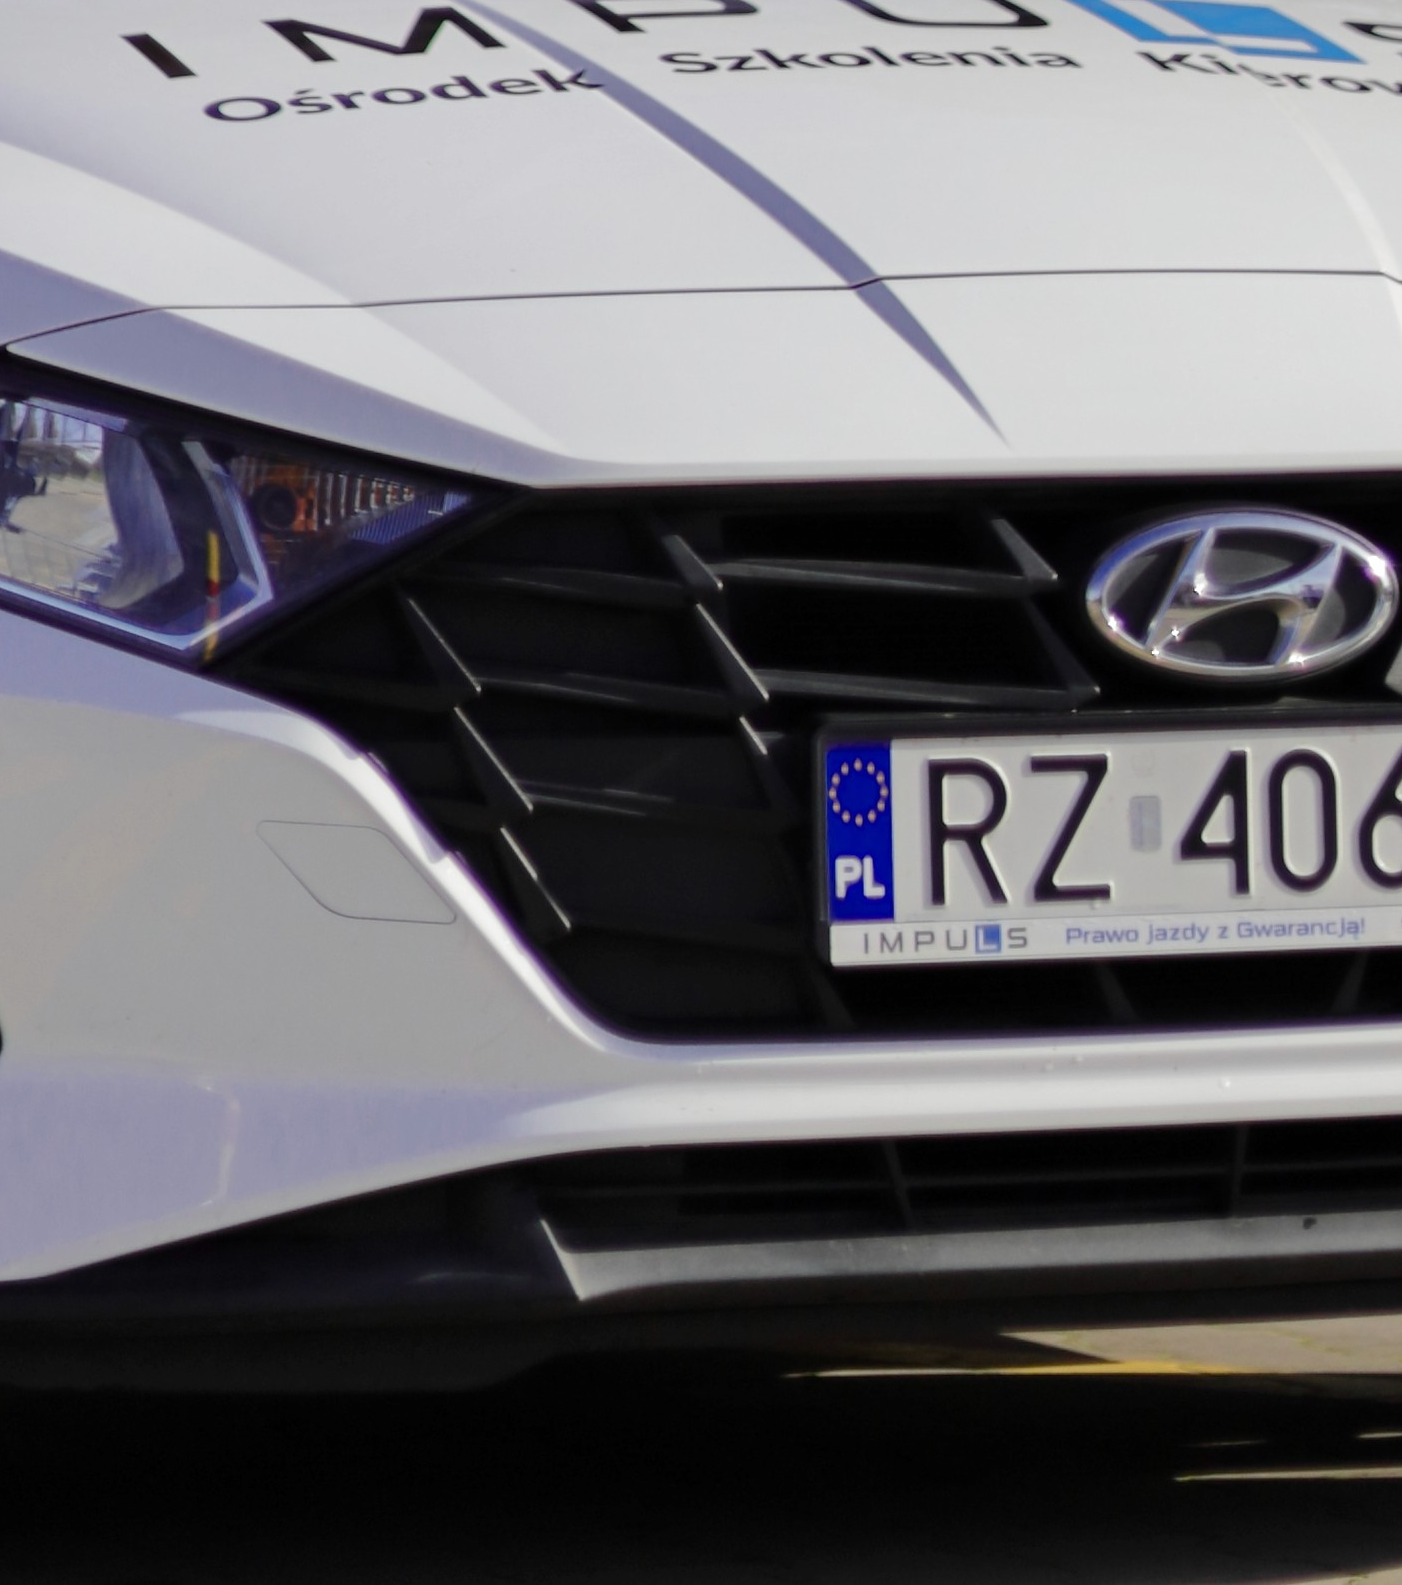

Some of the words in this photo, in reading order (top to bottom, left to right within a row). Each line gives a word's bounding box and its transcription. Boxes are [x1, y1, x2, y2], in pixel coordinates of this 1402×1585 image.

[203, 68, 605, 122] Ośrodek
[658, 45, 1085, 74] Szkolenia
[926, 752, 1115, 906] RZ
[834, 854, 886, 900] PL
[863, 924, 1028, 955] IMPULS
[1065, 927, 1140, 945] Prawo
[1217, 925, 1229, 940] z
[1236, 918, 1366, 940] Gwarancją!
